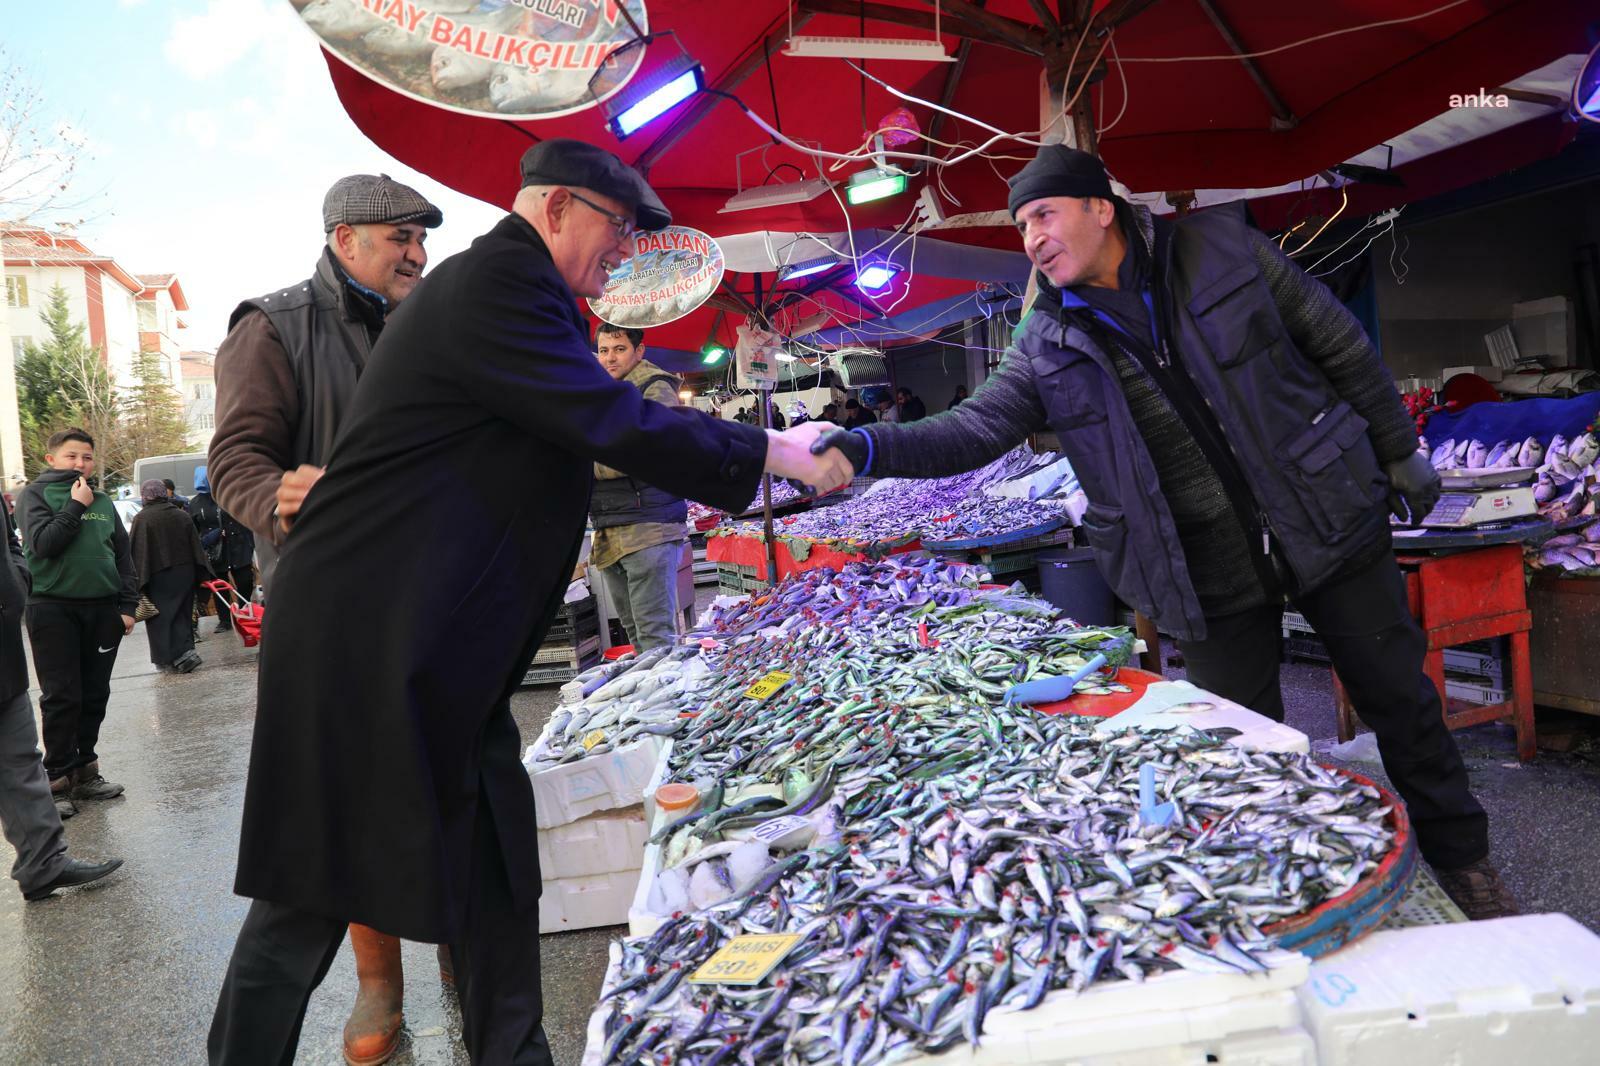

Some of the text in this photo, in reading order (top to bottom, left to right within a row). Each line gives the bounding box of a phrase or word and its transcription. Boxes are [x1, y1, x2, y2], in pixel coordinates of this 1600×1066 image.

[430, 16, 625, 74] BALIKÇILIK
[637, 233, 710, 257] DALYAN
[629, 268, 657, 282] KARATAY
